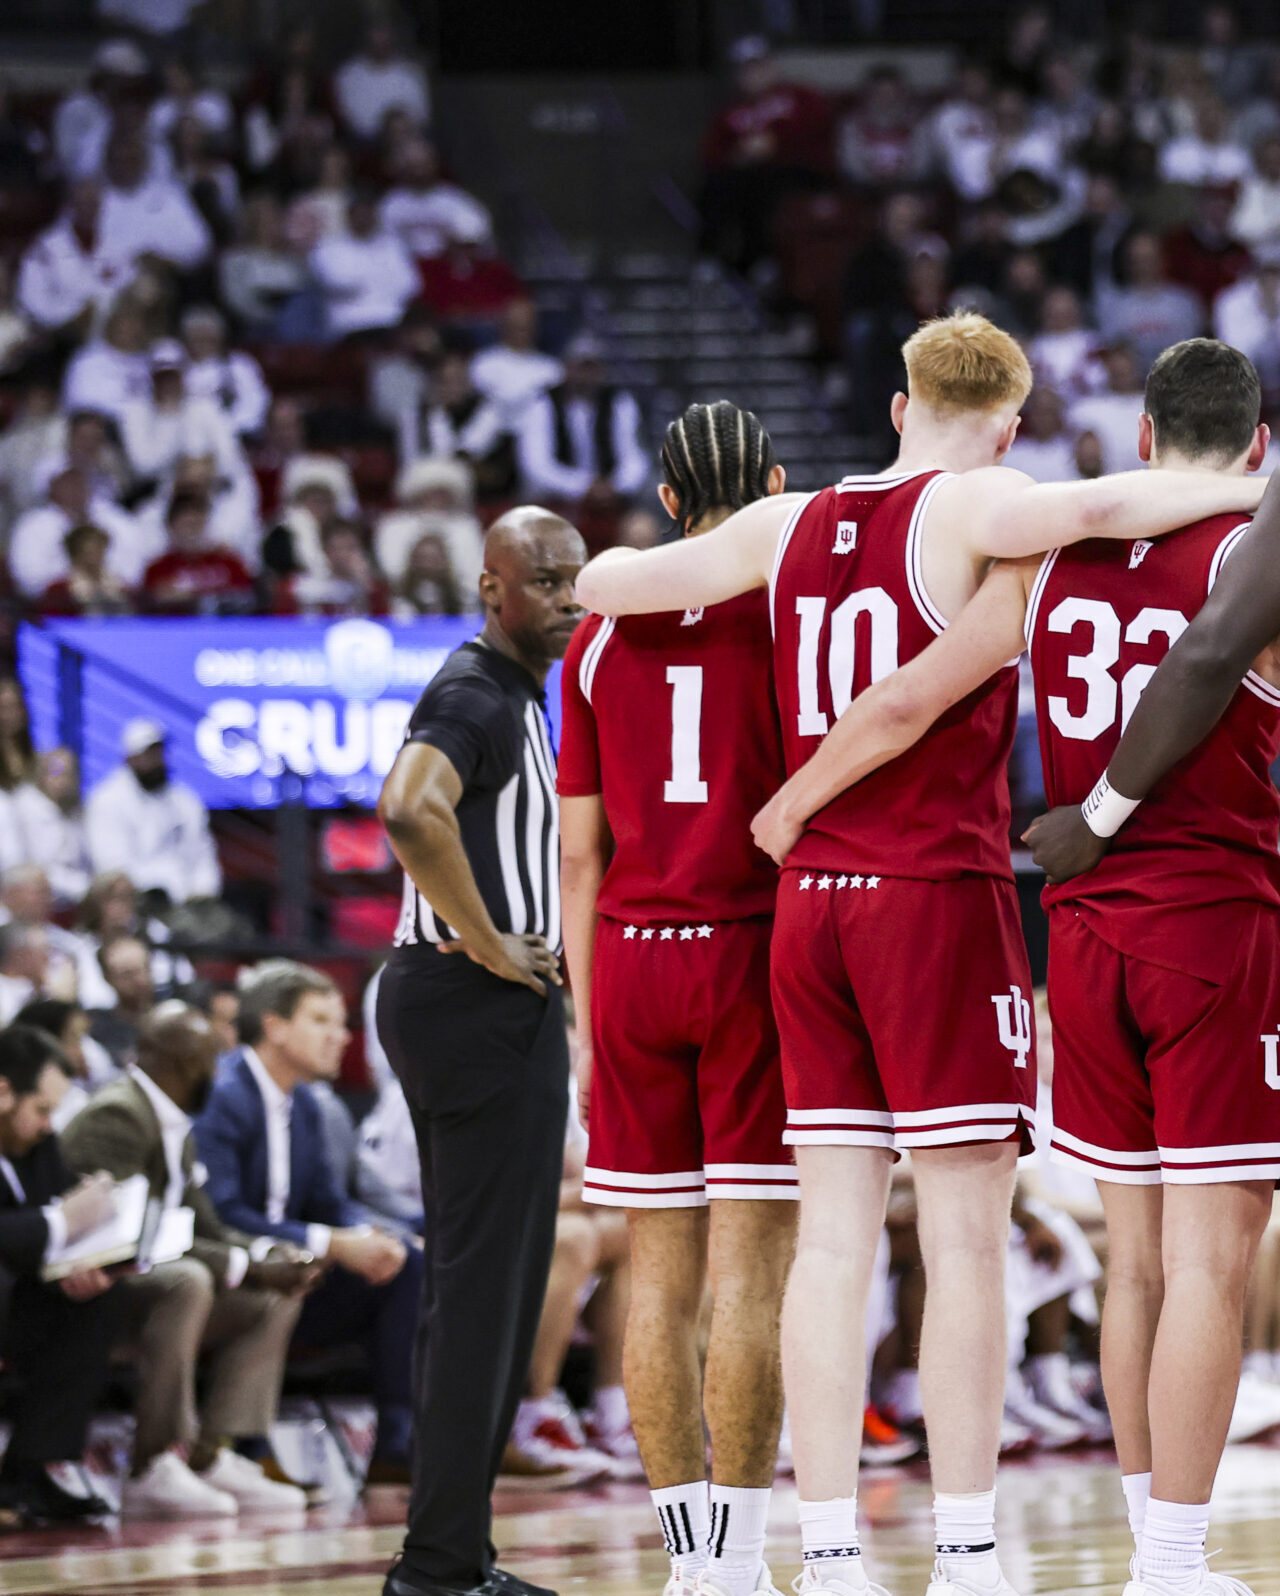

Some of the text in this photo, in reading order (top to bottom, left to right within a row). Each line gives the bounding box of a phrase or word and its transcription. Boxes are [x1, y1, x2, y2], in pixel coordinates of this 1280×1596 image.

[795, 587, 899, 736] 10
[1048, 596, 1190, 741] 32
[664, 666, 708, 803] 1
